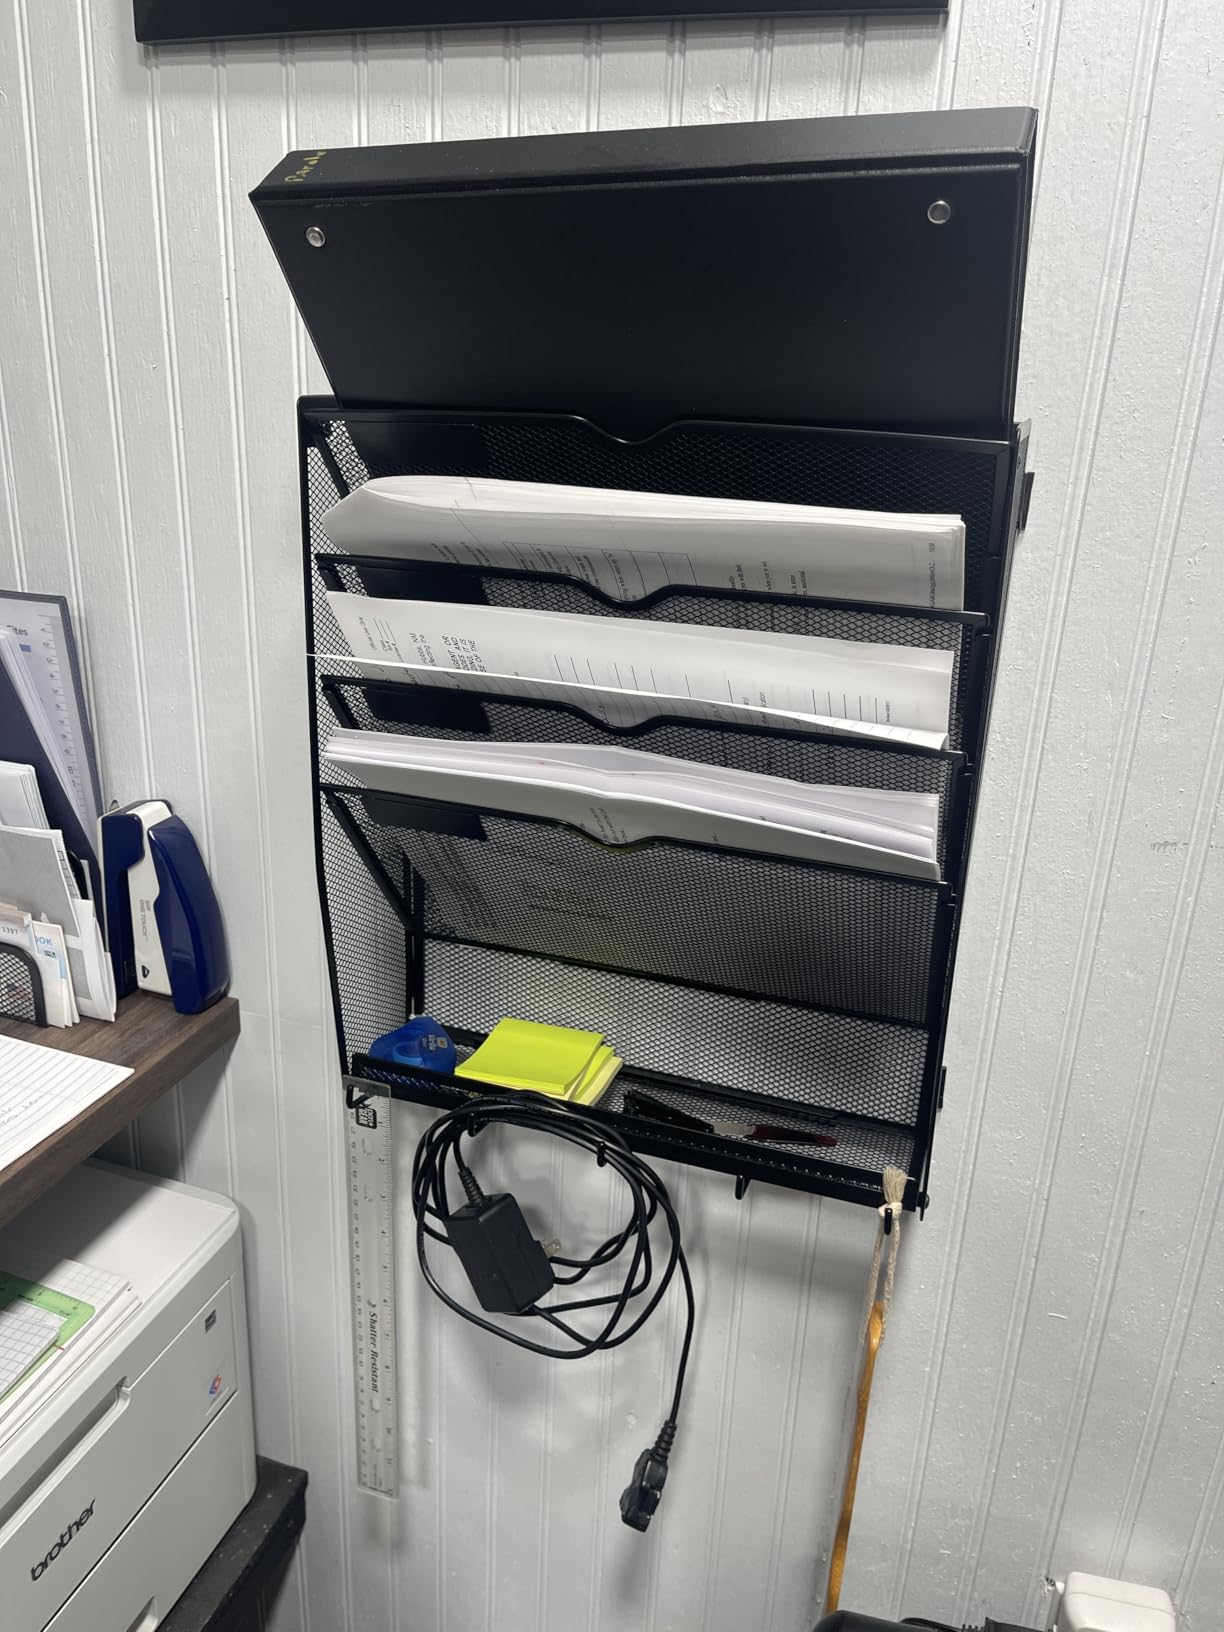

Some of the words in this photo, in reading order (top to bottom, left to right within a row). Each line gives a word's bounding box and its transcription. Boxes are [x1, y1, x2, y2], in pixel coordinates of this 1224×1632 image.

[442, 635, 452, 646] OR
[450, 637, 462, 652] AND
[468, 640, 477, 652] THE
[473, 653, 482, 663] OF
[369, 1312, 378, 1348] Shatter
[370, 1350, 379, 1392] Resistant
[30, 1498, 96, 1582] brother
